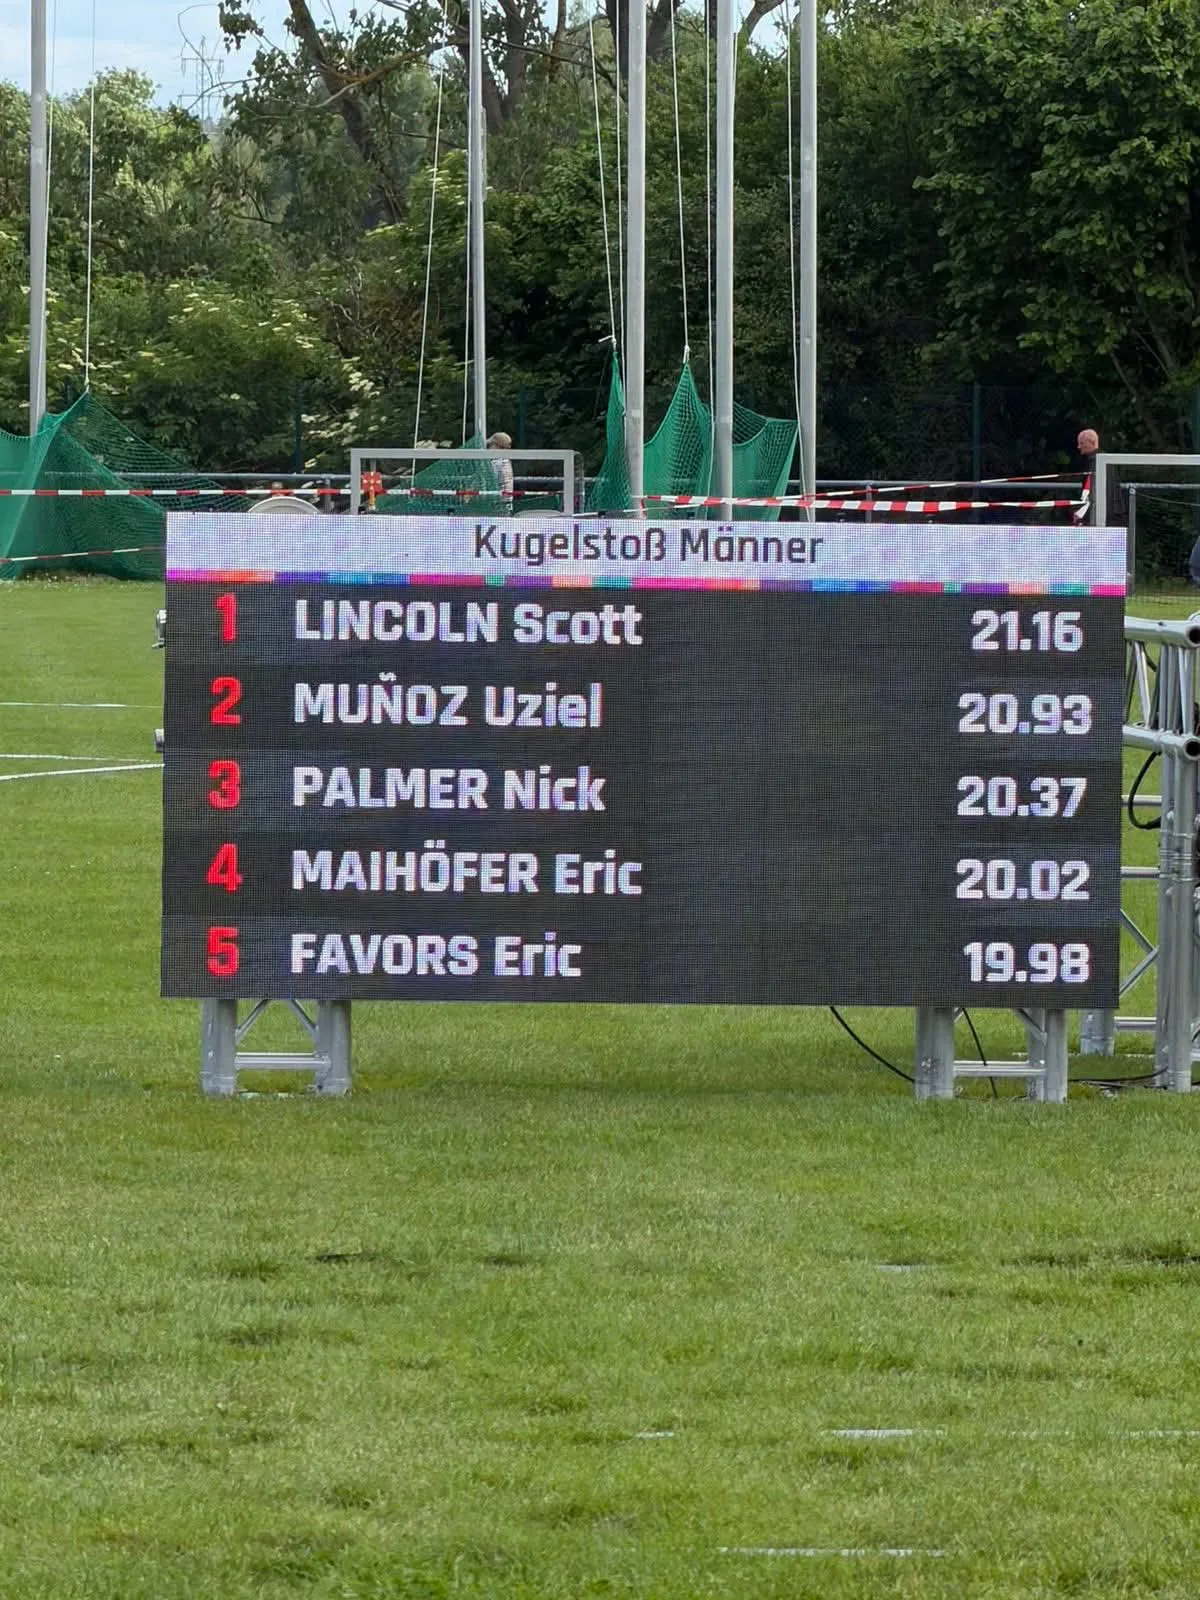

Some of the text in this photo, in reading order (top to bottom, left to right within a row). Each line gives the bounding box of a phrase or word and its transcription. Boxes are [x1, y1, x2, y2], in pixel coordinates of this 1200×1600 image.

[477, 523, 823, 565] Kugelstoß Männer
[216, 594, 1082, 651] 1 LINCOLN Scott 21.16
[211, 673, 1092, 734] 2 MUÑOZ Uziel 20.93
[209, 761, 1086, 817] 3 PALMER Nick 20.37
[207, 840, 1089, 900] 4 MAIHÖFER Eric 20.02
[207, 927, 1089, 982] 5 FAVORS Eric 19.98
